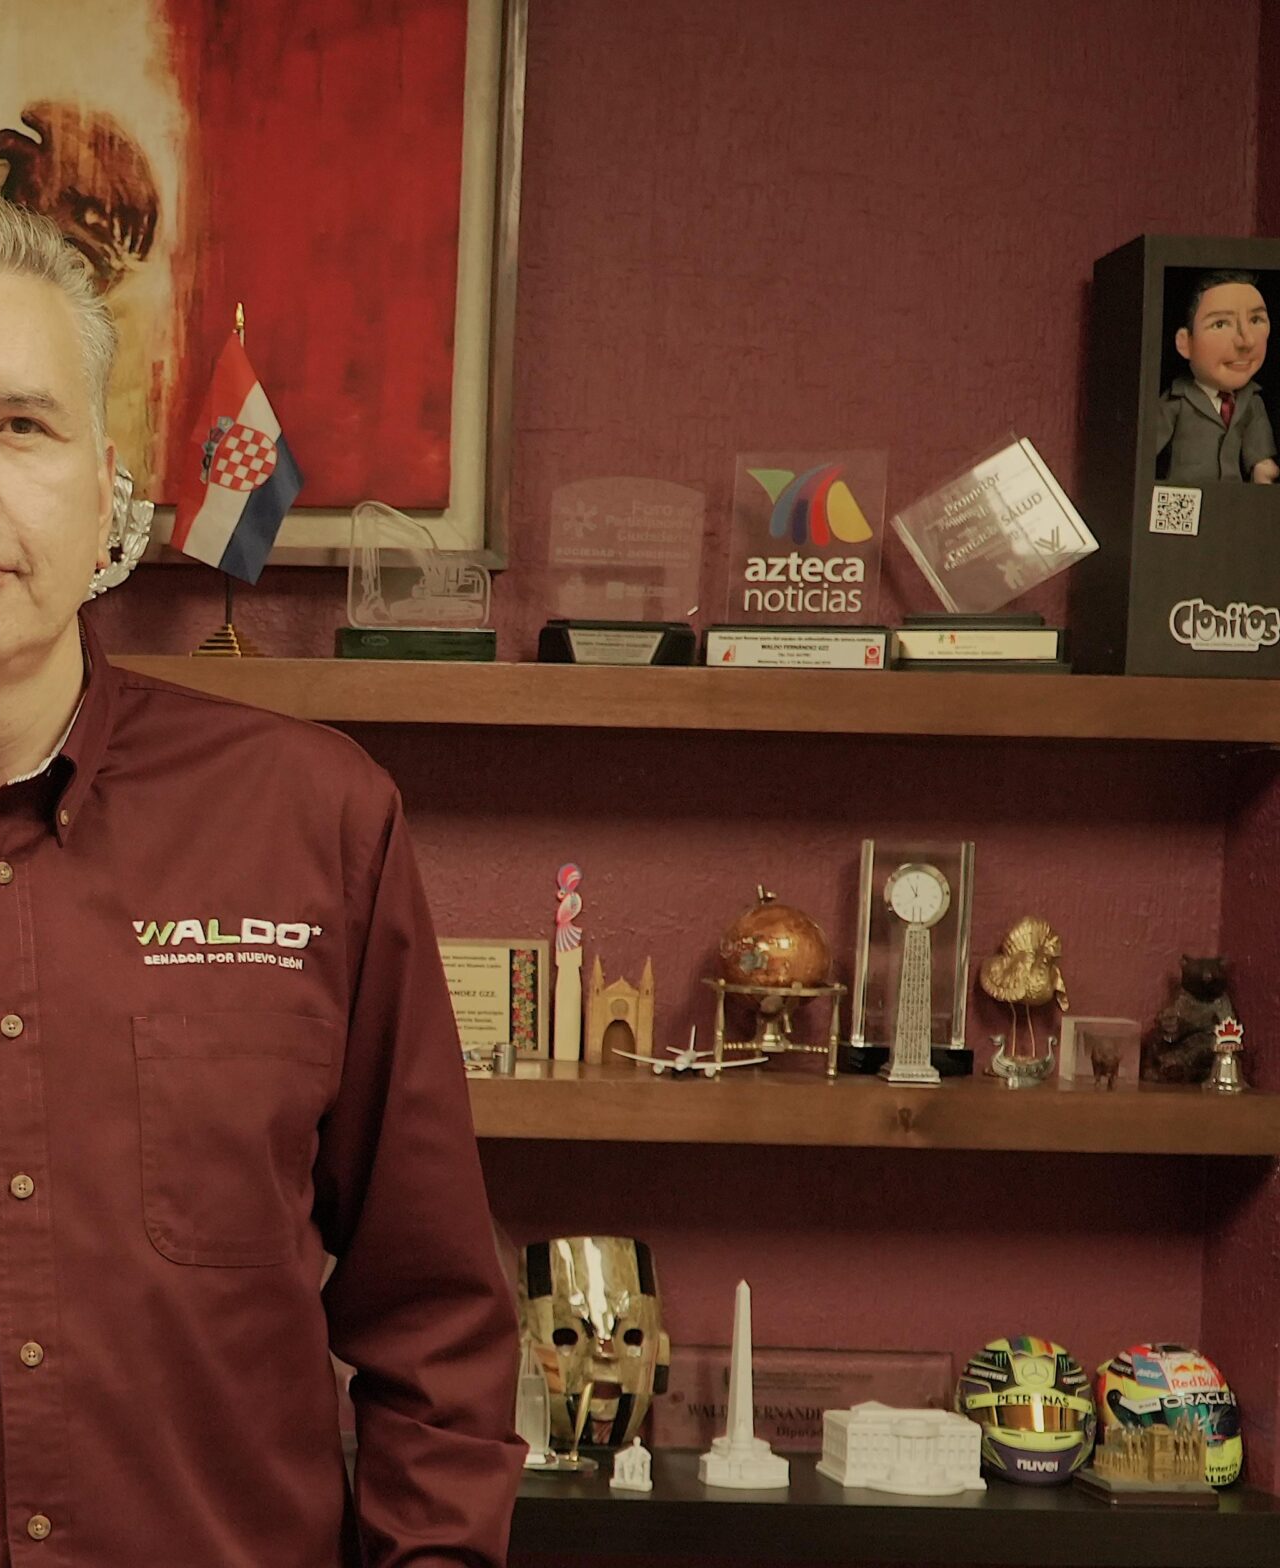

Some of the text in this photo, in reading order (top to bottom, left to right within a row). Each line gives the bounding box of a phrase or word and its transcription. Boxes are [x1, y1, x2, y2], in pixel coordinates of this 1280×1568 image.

[1000, 492, 1043, 527] SALUD
[745, 552, 865, 582] azteca
[743, 583, 862, 613] noticias
[1173, 602, 1278, 642] Clonitos
[132, 918, 312, 949] WALDO
[143, 952, 303, 970] SENADOR POR NUEVO LEÓN
[996, 1394, 1070, 1407] PETRNAS
[1164, 1392, 1231, 1409] ORACLE
